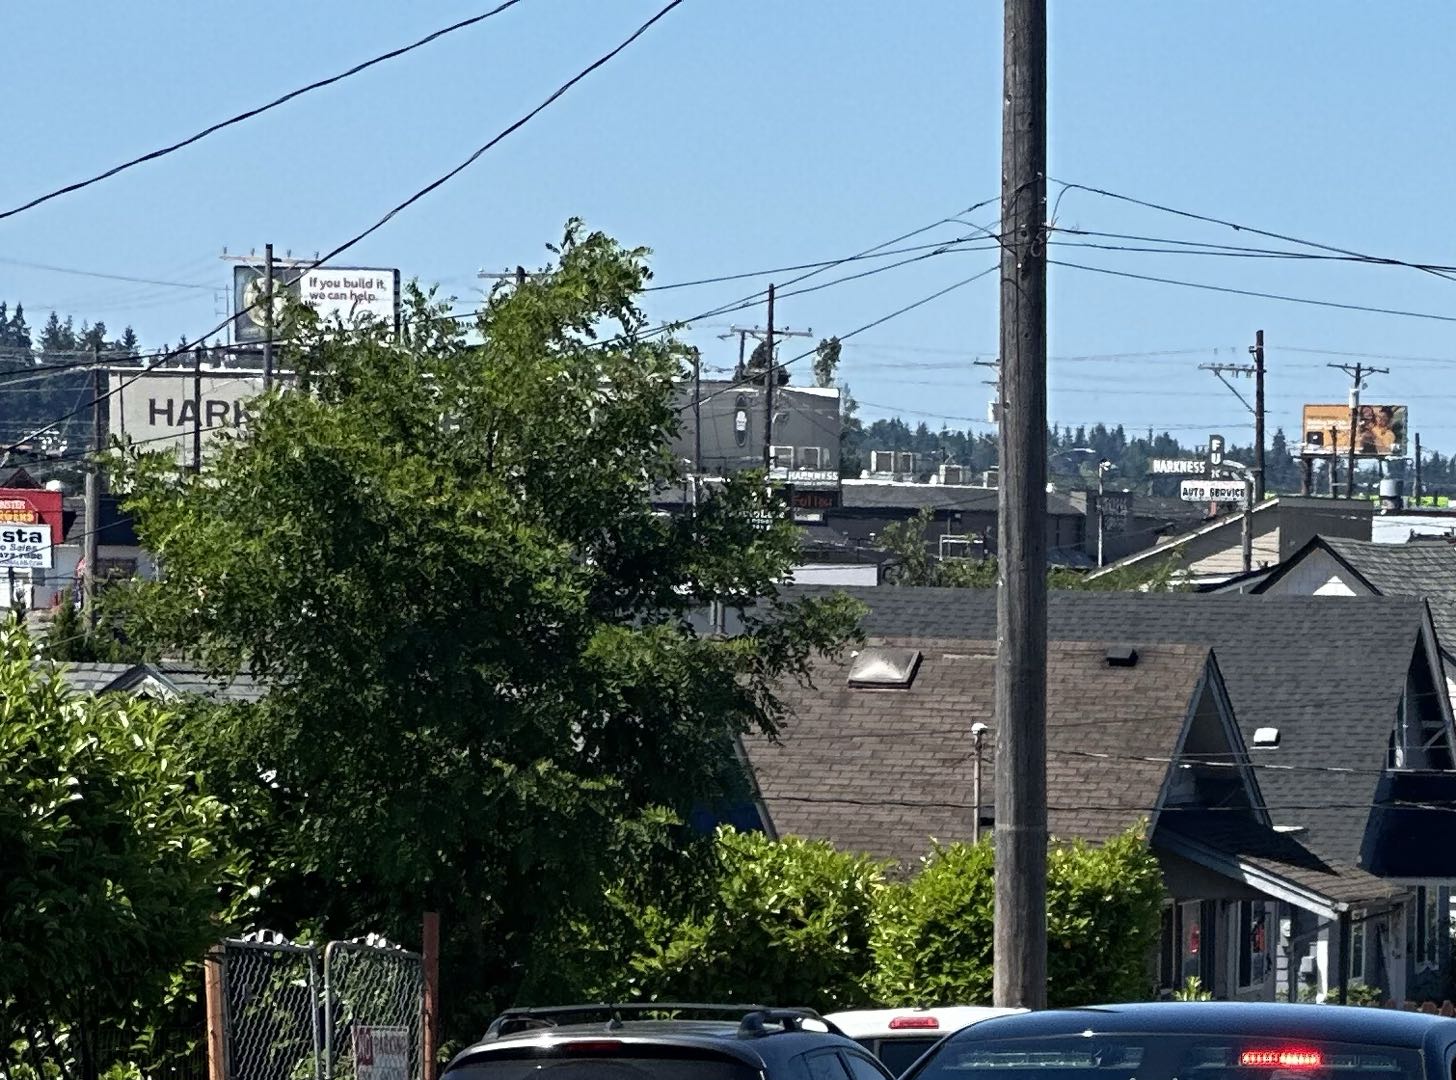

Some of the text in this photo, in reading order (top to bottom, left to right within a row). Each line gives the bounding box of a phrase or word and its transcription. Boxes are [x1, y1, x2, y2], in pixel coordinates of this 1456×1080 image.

[309, 277, 318, 287] If
[320, 279, 341, 290] you
[343, 278, 374, 289] build
[309, 292, 326, 300] we
[328, 292, 347, 300] can
[1153, 460, 1206, 473] HARKNESS
[1182, 487, 1245, 498] AUTO SERVICE
